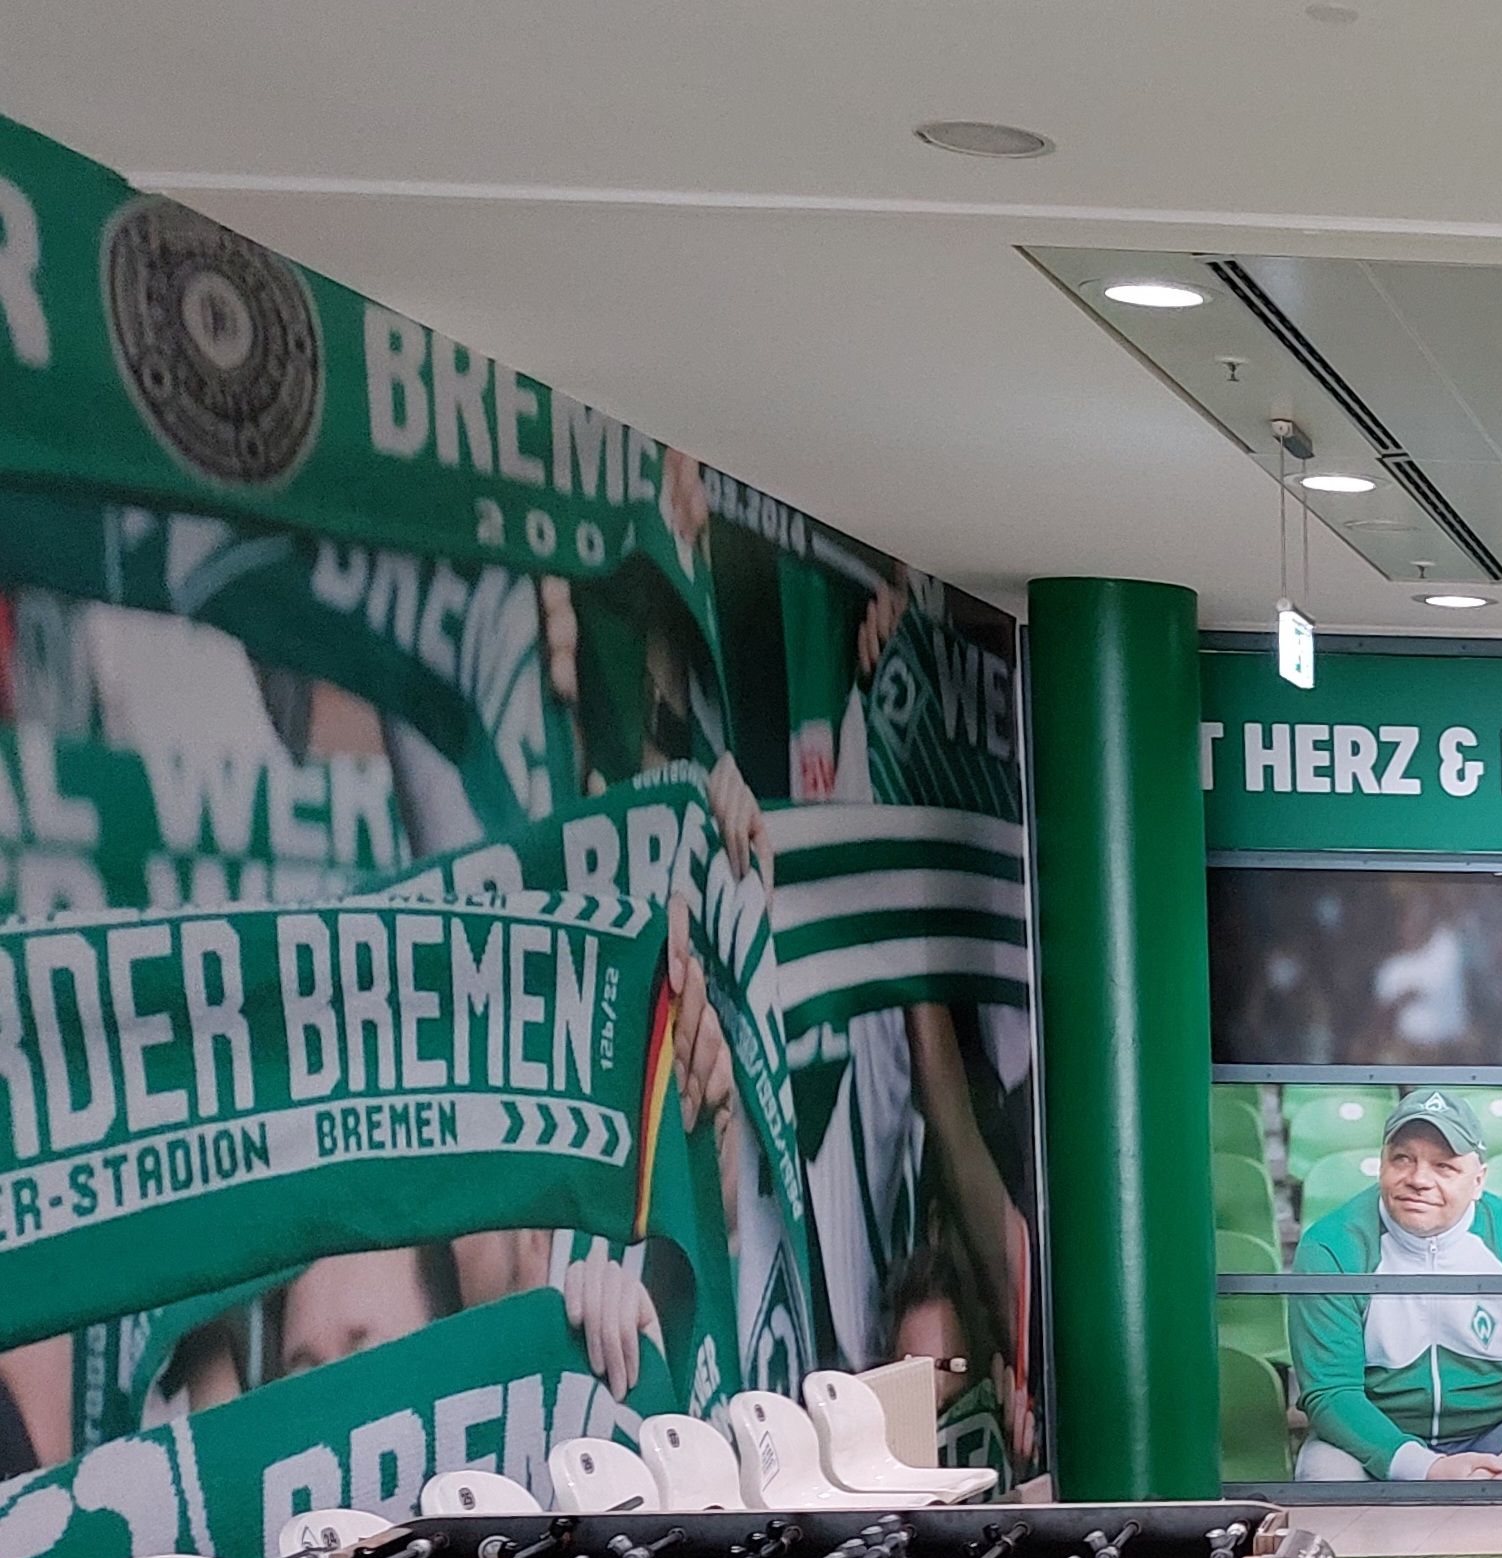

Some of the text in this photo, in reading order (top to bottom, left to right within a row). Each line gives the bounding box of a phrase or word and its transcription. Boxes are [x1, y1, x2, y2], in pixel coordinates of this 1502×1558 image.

[1243, 722, 1422, 796] HERZ
[1438, 727, 1484, 797] &
[276, 911, 599, 1104] BREMEN
[0, 1100, 457, 1242] R-STADION BREMEN
